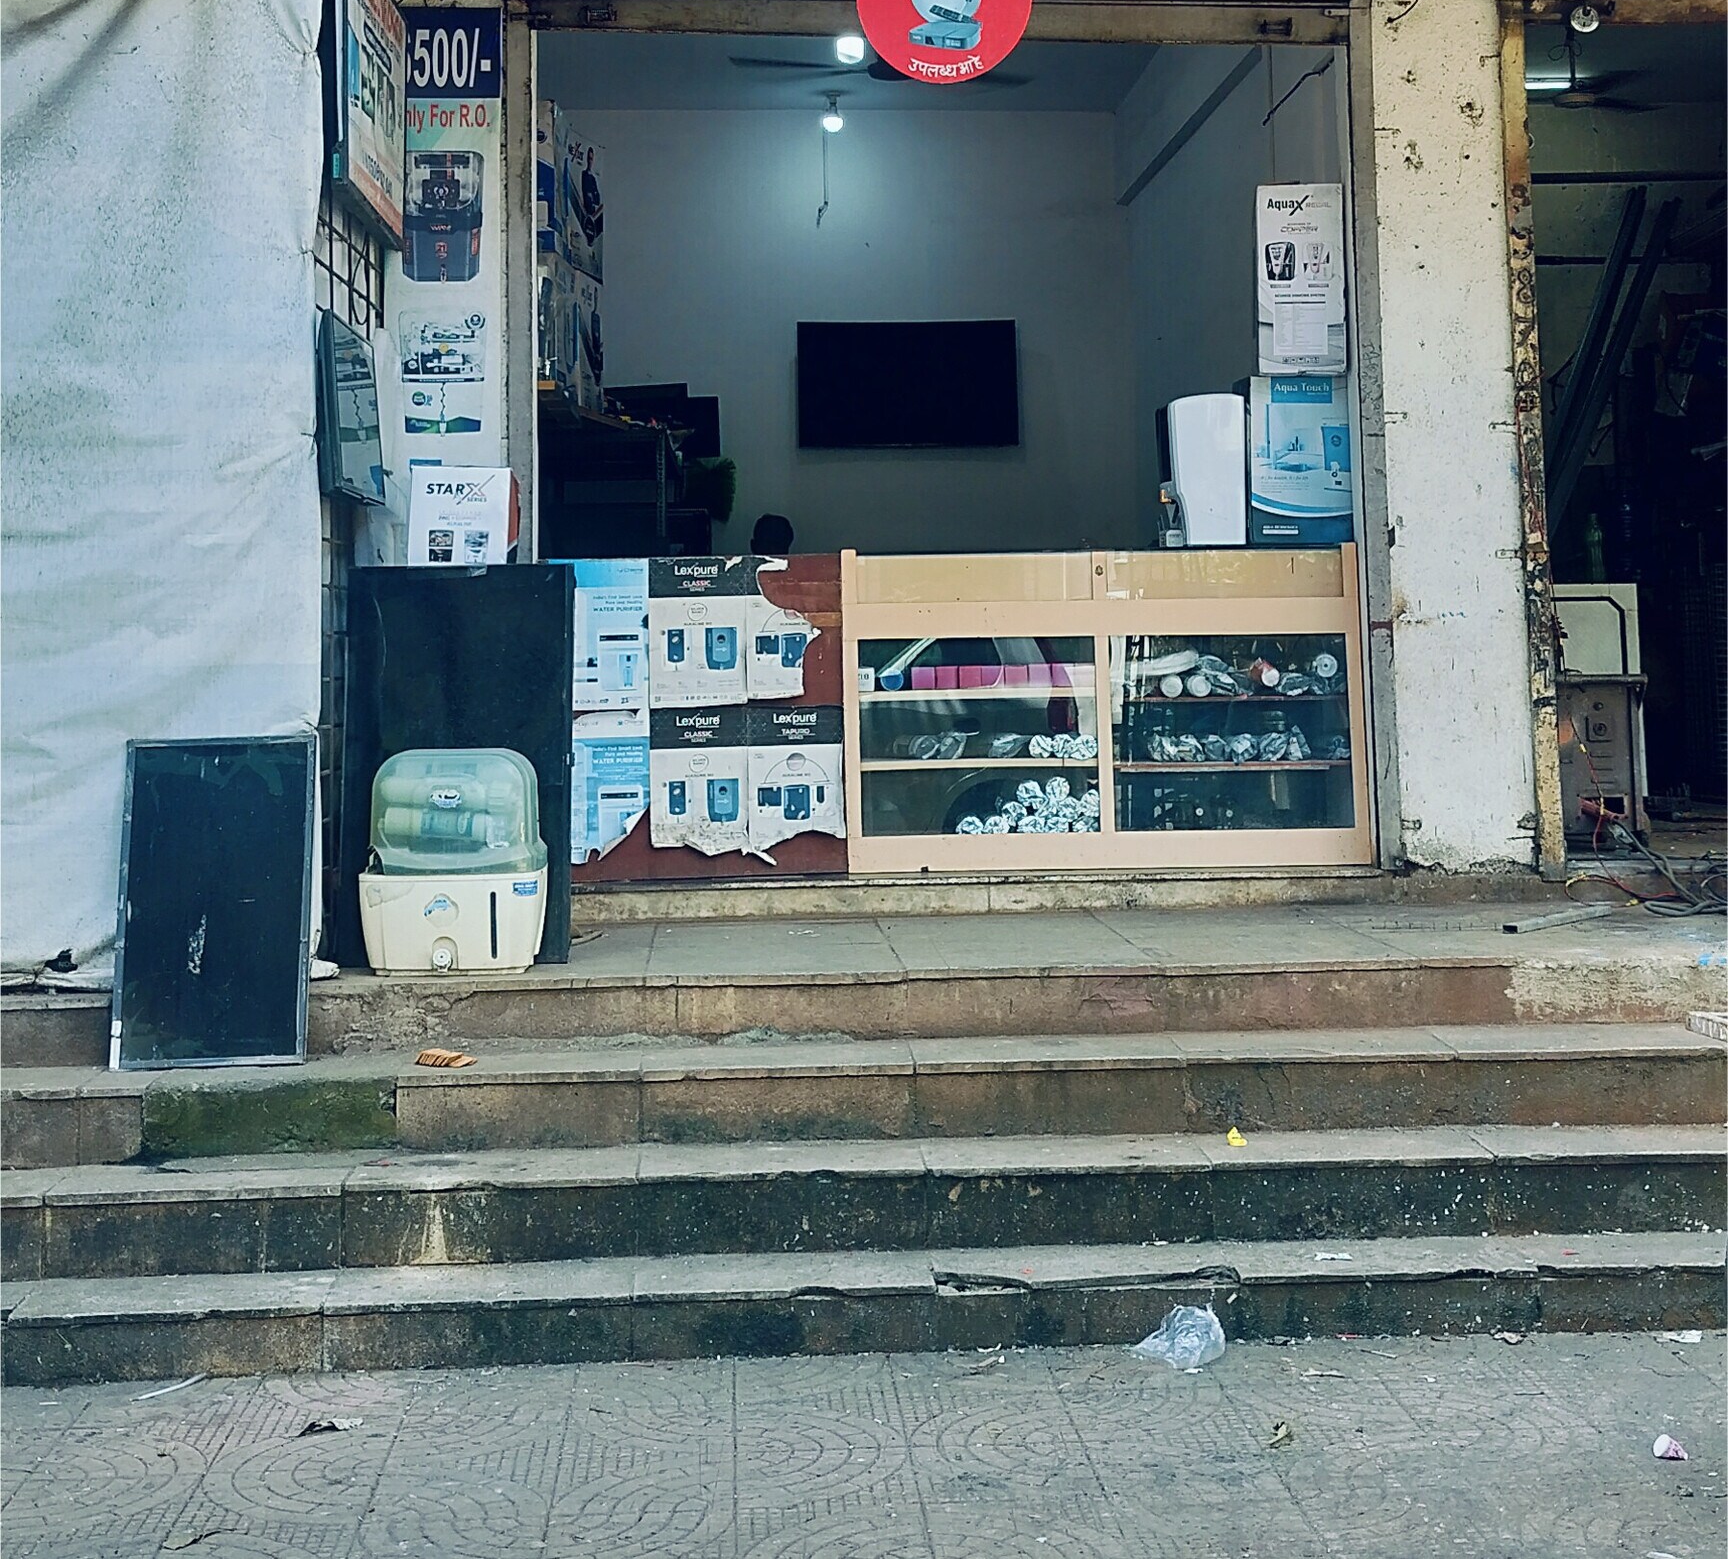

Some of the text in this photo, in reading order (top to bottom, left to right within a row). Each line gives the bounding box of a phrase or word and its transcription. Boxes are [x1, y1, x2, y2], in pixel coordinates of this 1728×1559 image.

[405, 27, 492, 88] 500/-
[430, 103, 456, 128] For
[460, 103, 491, 128] R.O.
[1273, 382, 1330, 394] Aqua Touch
[674, 563, 719, 577] Lexpure
[676, 712, 721, 728] Lexpure
[773, 710, 817, 726] Lexpure
[683, 730, 713, 738] CLASSIC
